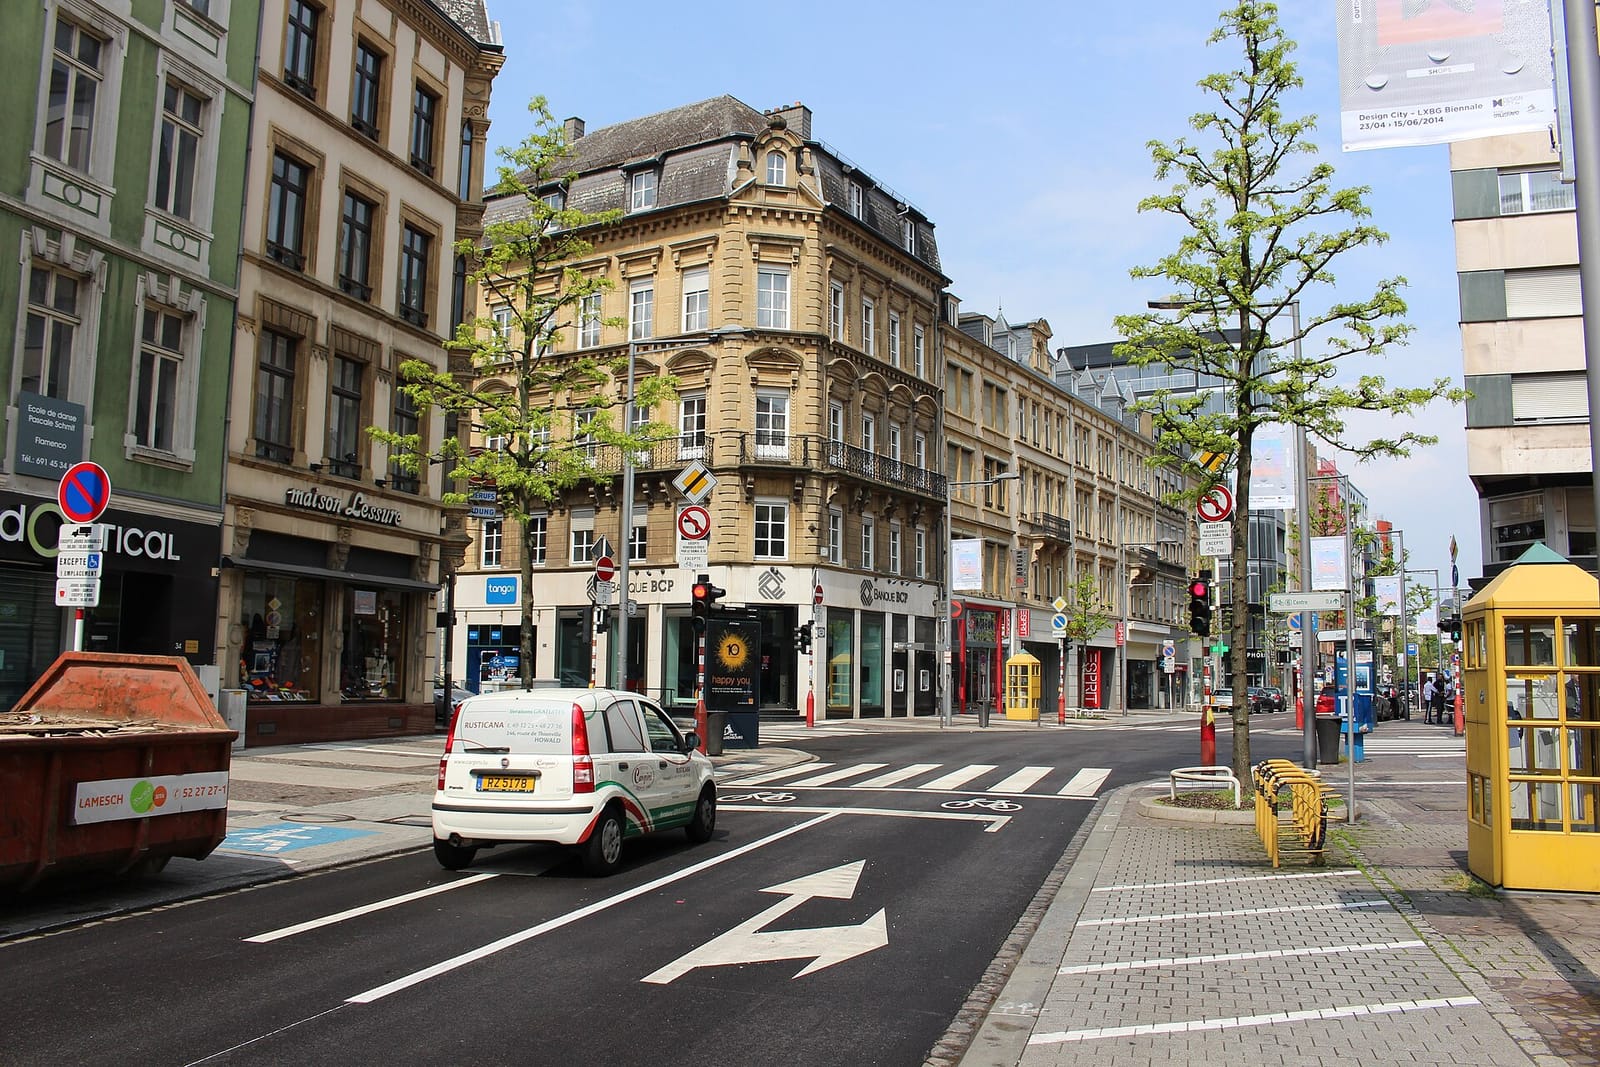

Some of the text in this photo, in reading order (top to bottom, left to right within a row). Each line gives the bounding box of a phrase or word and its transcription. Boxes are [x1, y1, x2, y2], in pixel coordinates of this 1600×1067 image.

[1359, 112, 1389, 122] Design
[1390, 109, 1408, 119] City
[1417, 107, 1442, 116] LXBG
[1445, 103, 1484, 113] Biennale
[1359, 116, 1445, 130] 23/04 15/06/2014
[28, 404, 78, 422] Ecole de danse
[28, 414, 54, 427] Pascale
[34, 436, 67, 449] Flamenco
[36, 457, 48, 466] 691
[49, 460, 58, 468] 45
[286, 487, 402, 526] maison Lessure
[59, 557, 87, 566] EXCEPTE
[611, 581, 648, 594] BAQUE
[651, 579, 674, 593] BCP
[1020, 609, 1029, 636] ESPRIT
[711, 674, 735, 686] happy
[1085, 652, 1098, 705] ESPRIT
[464, 721, 505, 729] RUSTICANA
[534, 736, 562, 744] HOWALD
[488, 777, 528, 789] RZ 5178
[79, 793, 124, 809] LAMESCH
[183, 787, 193, 798] 52
[195, 786, 206, 797] 27
[207, 785, 226, 796] 27-1
